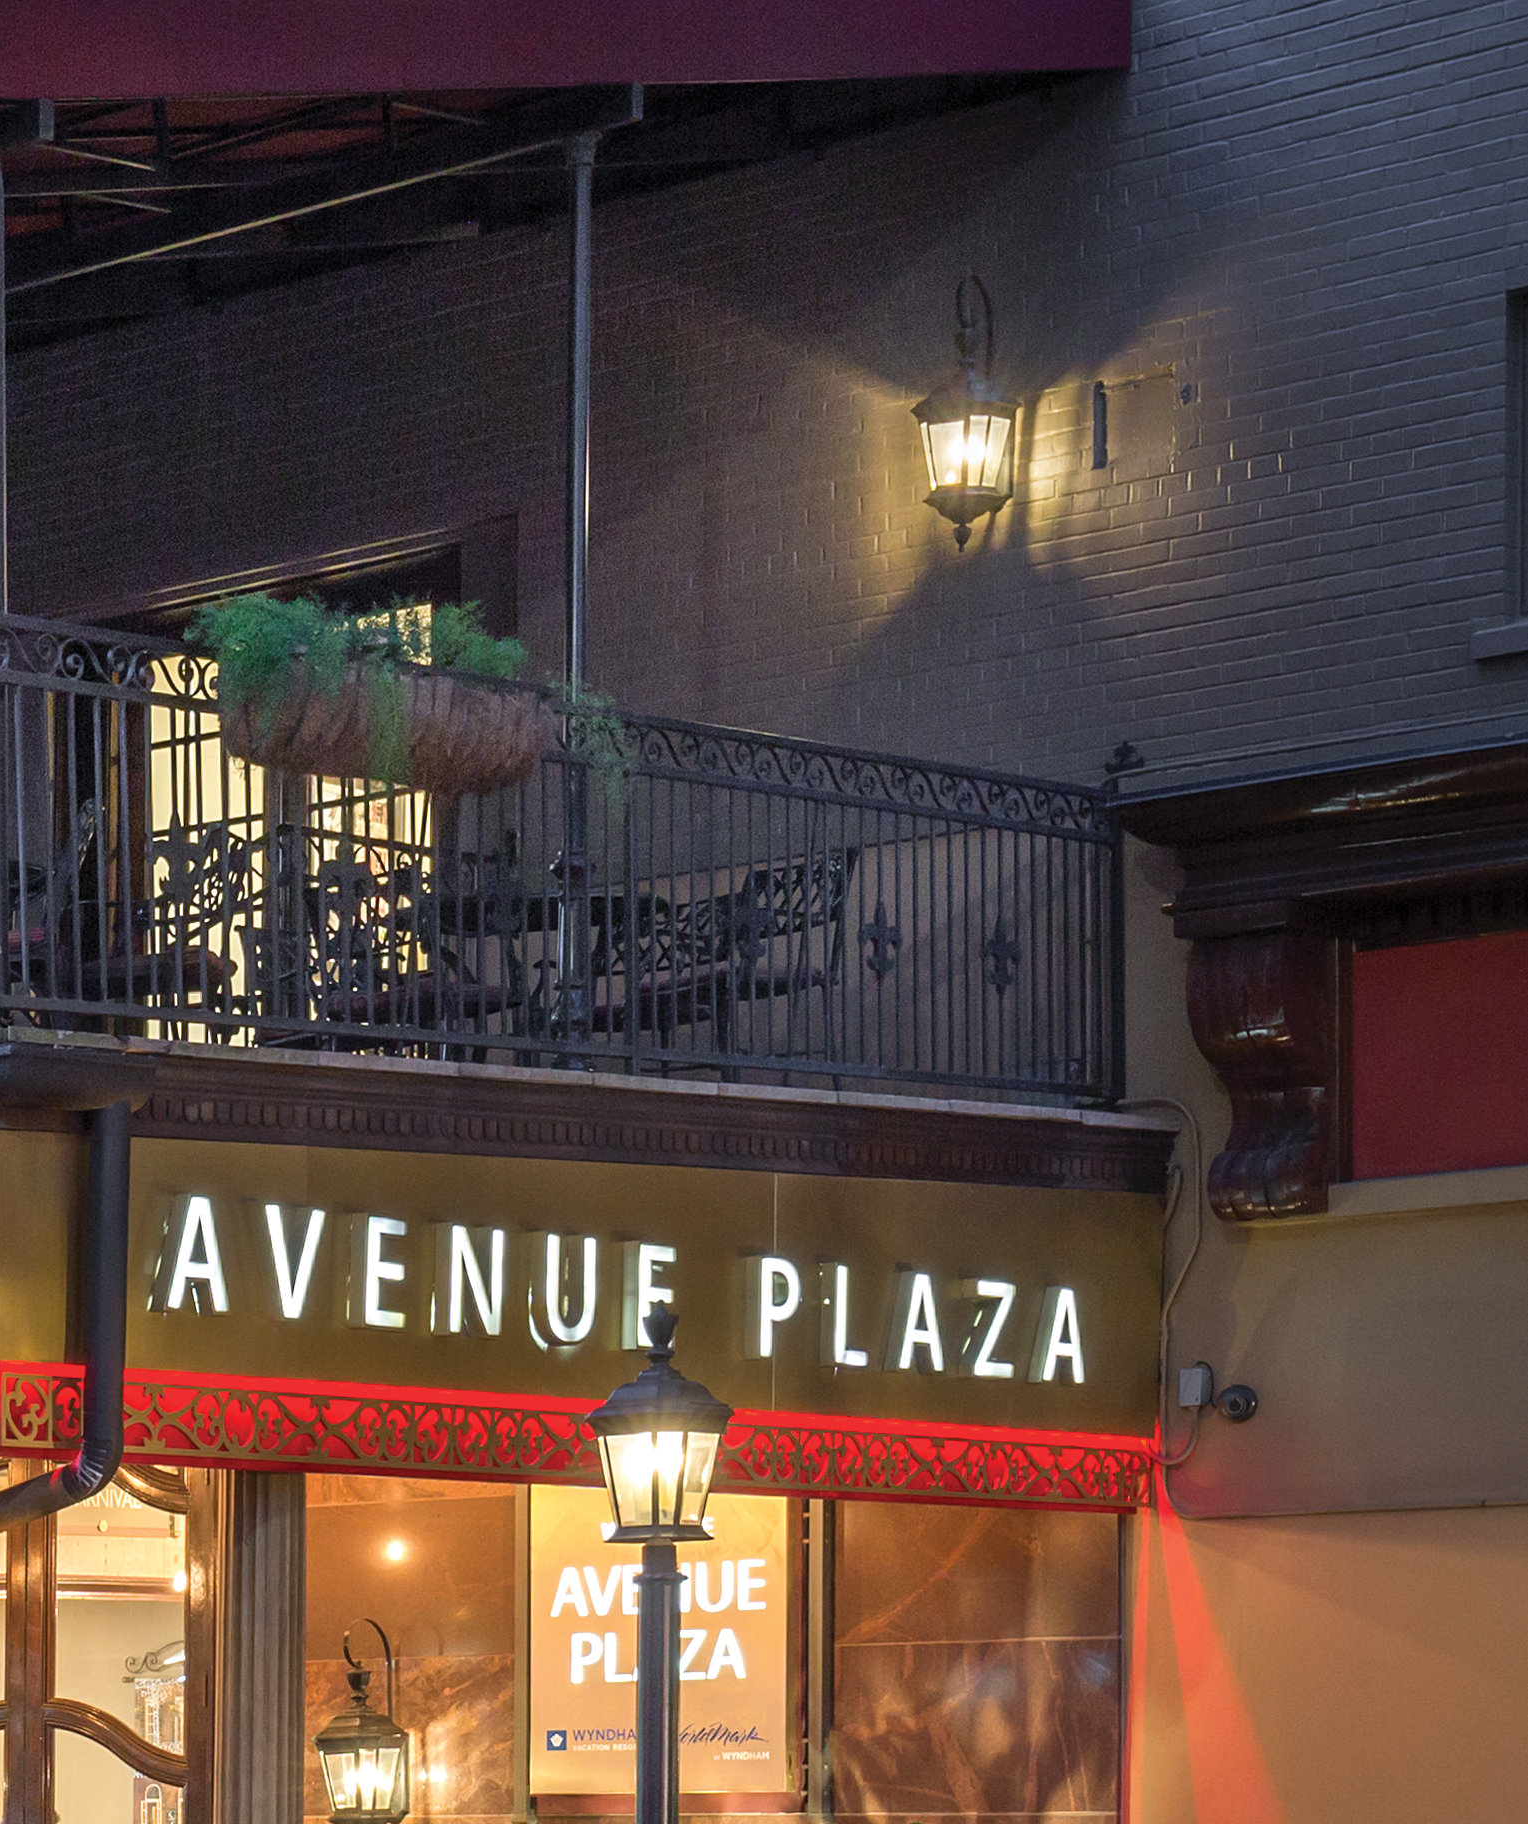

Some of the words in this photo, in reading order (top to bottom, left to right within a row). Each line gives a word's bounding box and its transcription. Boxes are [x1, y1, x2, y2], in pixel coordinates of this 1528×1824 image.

[161, 1196, 675, 1348] AVENUE
[756, 1257, 1084, 1385] PLAZA
[570, 1628, 747, 1684] PLZA
[572, 1729, 637, 1741] WYNDHA
[612, 1743, 637, 1752] RESO
[722, 1751, 770, 1761] WYNDHAM
